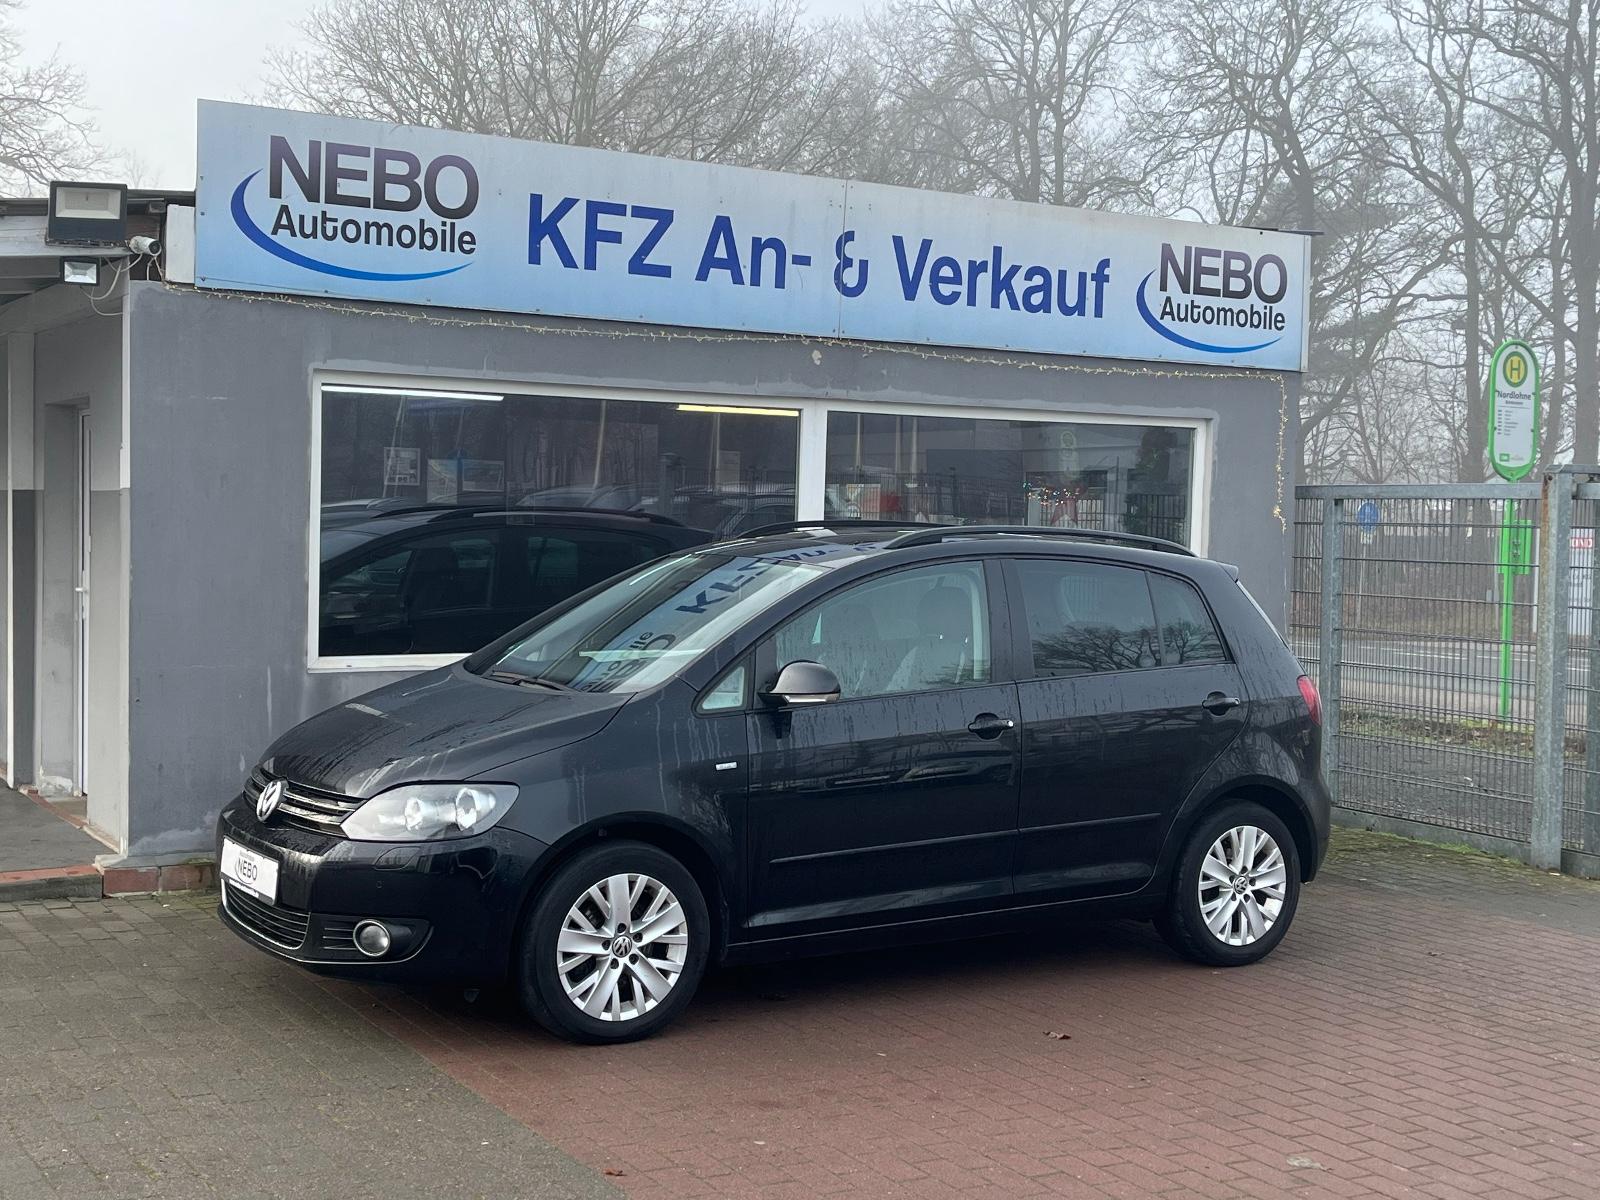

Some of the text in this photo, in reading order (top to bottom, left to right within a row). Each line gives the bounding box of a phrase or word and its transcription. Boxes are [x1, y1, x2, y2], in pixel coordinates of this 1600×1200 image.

[269, 135, 479, 220] NEBO
[270, 204, 477, 255] Automobile
[527, 192, 1111, 319] KFZ An- & Verkauf
[1159, 242, 1288, 304] NEBO
[1159, 295, 1286, 332] Automobile
[1497, 391, 1532, 400] Nordlohne
[238, 858, 258, 881] NEBO
